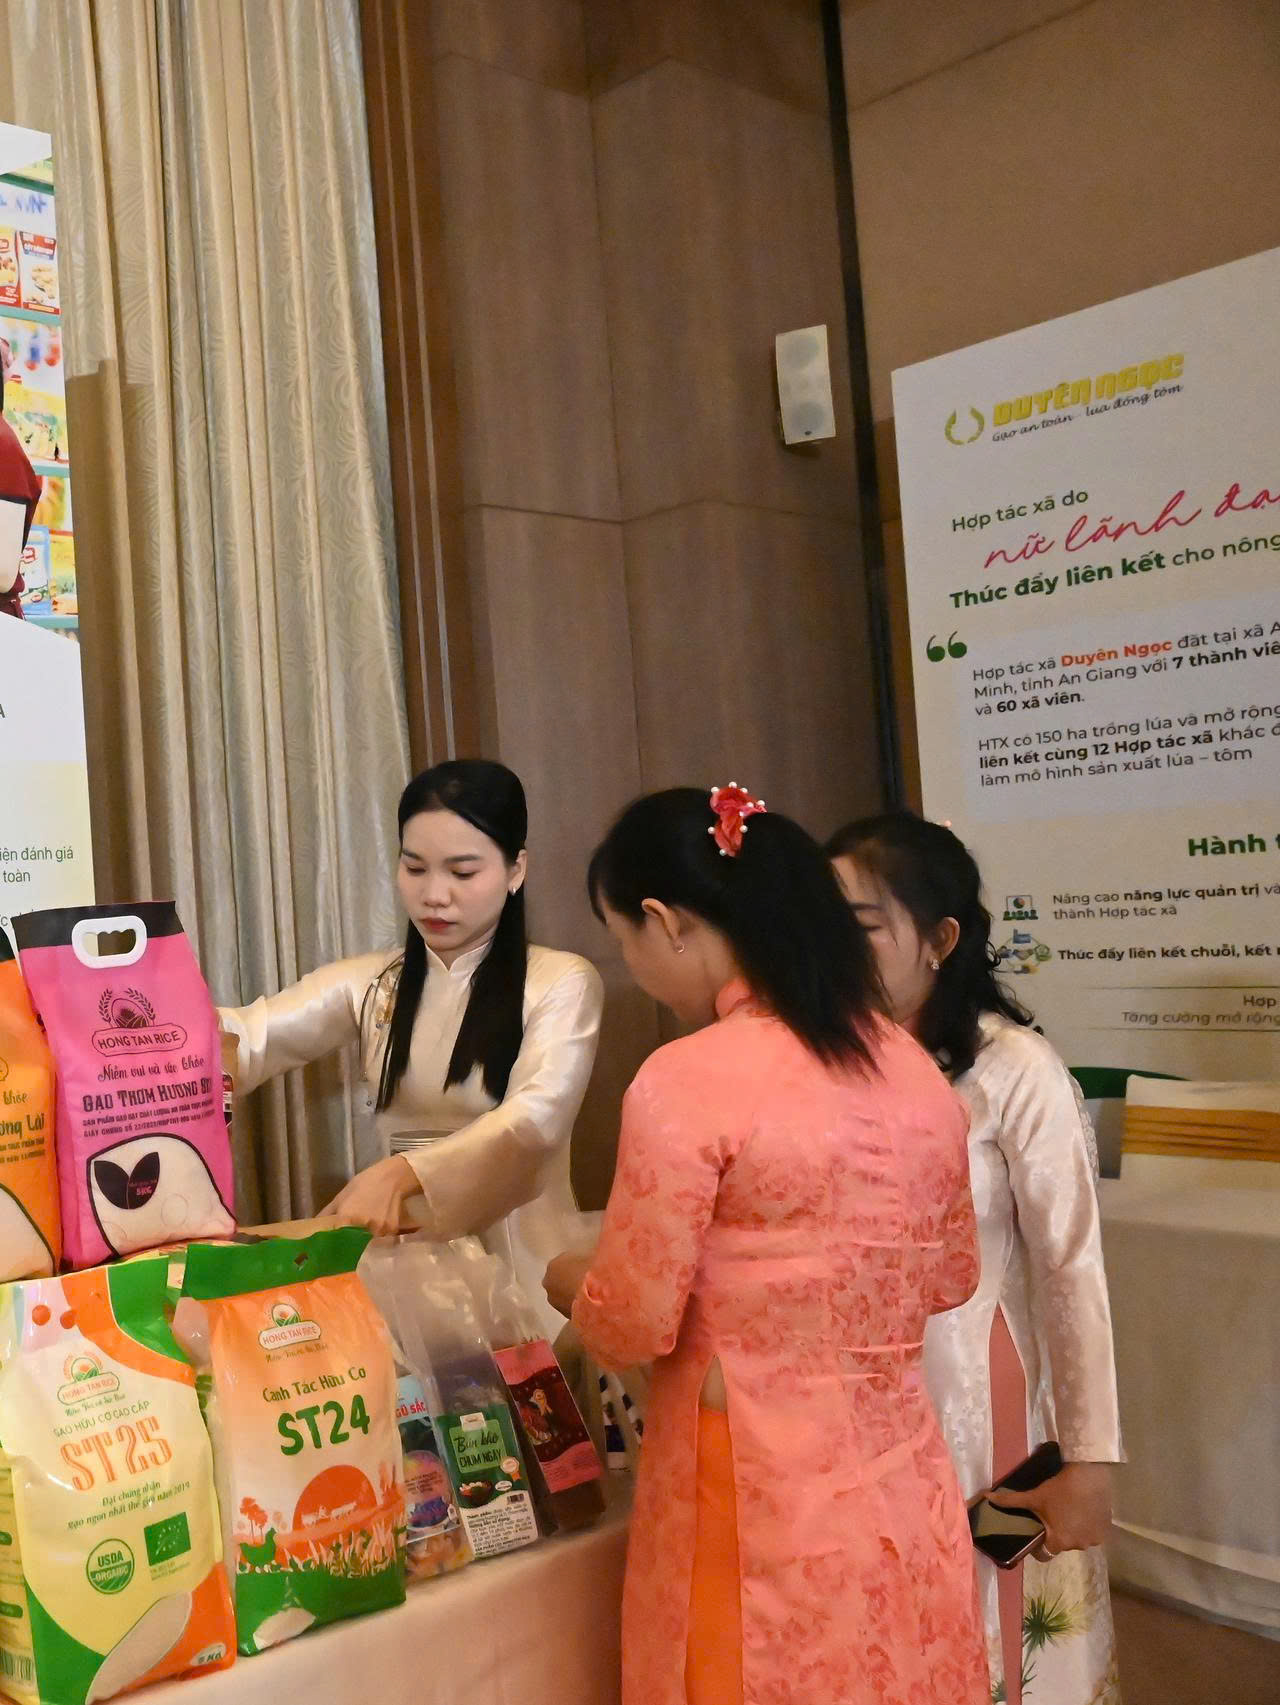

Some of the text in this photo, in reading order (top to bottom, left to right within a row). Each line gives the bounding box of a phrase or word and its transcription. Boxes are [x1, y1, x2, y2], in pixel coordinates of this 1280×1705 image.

[952, 490, 1089, 532] Hợp tác xã do
[984, 532, 1055, 569] nữ
[1065, 490, 1202, 552] lãnh
[950, 534, 1280, 609] Thúc đẩy liên kết cho nông
[975, 691, 1085, 716] và 60 xã viên.
[1188, 834, 1267, 856] Hành
[1058, 949, 1094, 960] Thúc
[1129, 945, 1156, 959] liên
[1161, 943, 1186, 958] kết
[1244, 942, 1272, 957] kết
[98, 1031, 181, 1049] HONG TAN RICE
[83, 1094, 114, 1114] GẠO
[117, 1088, 155, 1107] THƠM
[157, 1081, 198, 1102] HƯƠNG
[26, 1113, 45, 1131] Lài
[262, 1333, 287, 1345] HONG
[289, 1328, 302, 1338] TAN
[262, 1388, 291, 1402] Canh
[292, 1379, 318, 1397] Tác
[278, 1394, 370, 1456] ST24
[60, 1416, 173, 1492] ST25
[98, 1552, 124, 1568] USDA
[93, 1564, 129, 1582] ORGANIC
